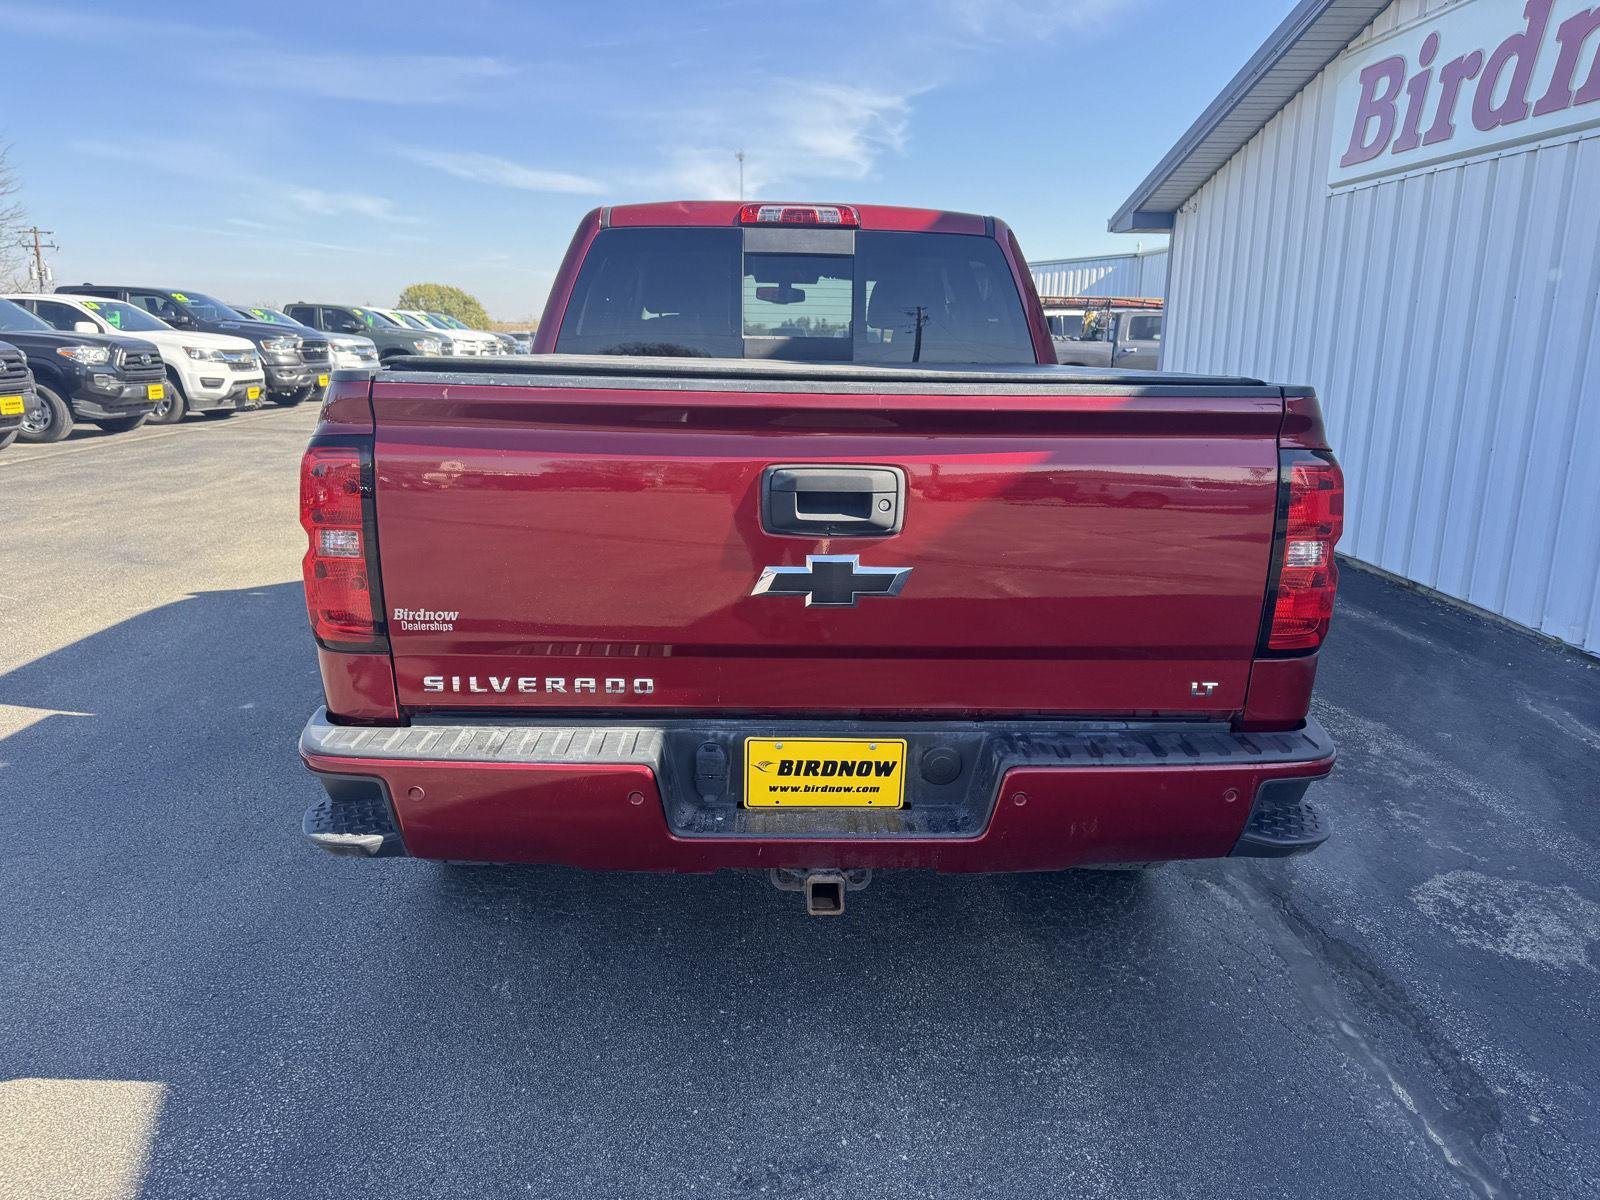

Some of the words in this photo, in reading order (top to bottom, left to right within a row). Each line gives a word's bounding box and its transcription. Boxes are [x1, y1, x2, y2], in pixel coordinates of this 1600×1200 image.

[393, 608, 459, 621] Birdnow
[401, 620, 454, 632] Dealerships
[423, 675, 655, 694] SILVERADO
[1191, 682, 1219, 697] LT
[777, 759, 898, 777] BIRDNOW
[768, 784, 881, 793] www.birdnow.com
